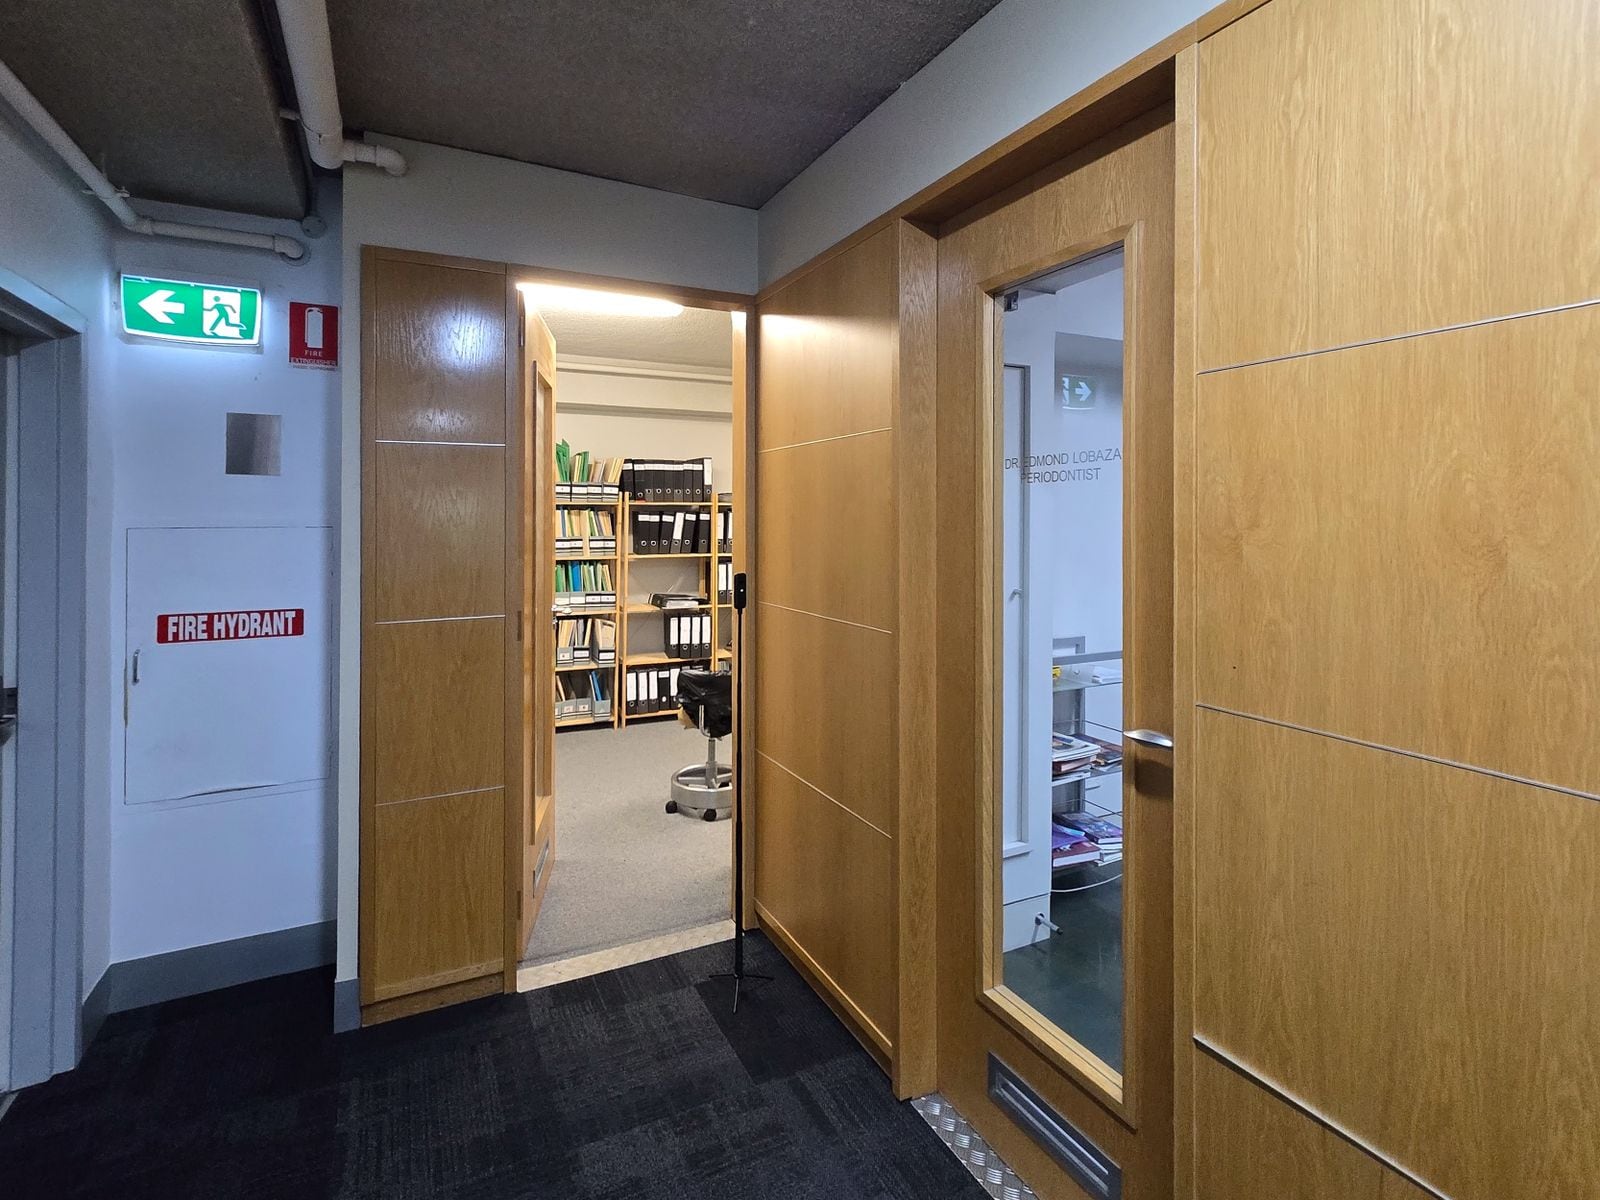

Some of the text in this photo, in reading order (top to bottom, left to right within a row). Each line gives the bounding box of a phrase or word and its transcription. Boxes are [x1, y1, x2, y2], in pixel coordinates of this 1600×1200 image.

[1005, 448, 1122, 470] DR. EDMOND LOBAZA
[1020, 468, 1102, 484] PERIODONTIST
[168, 610, 296, 641] FIRE HYDRANT
